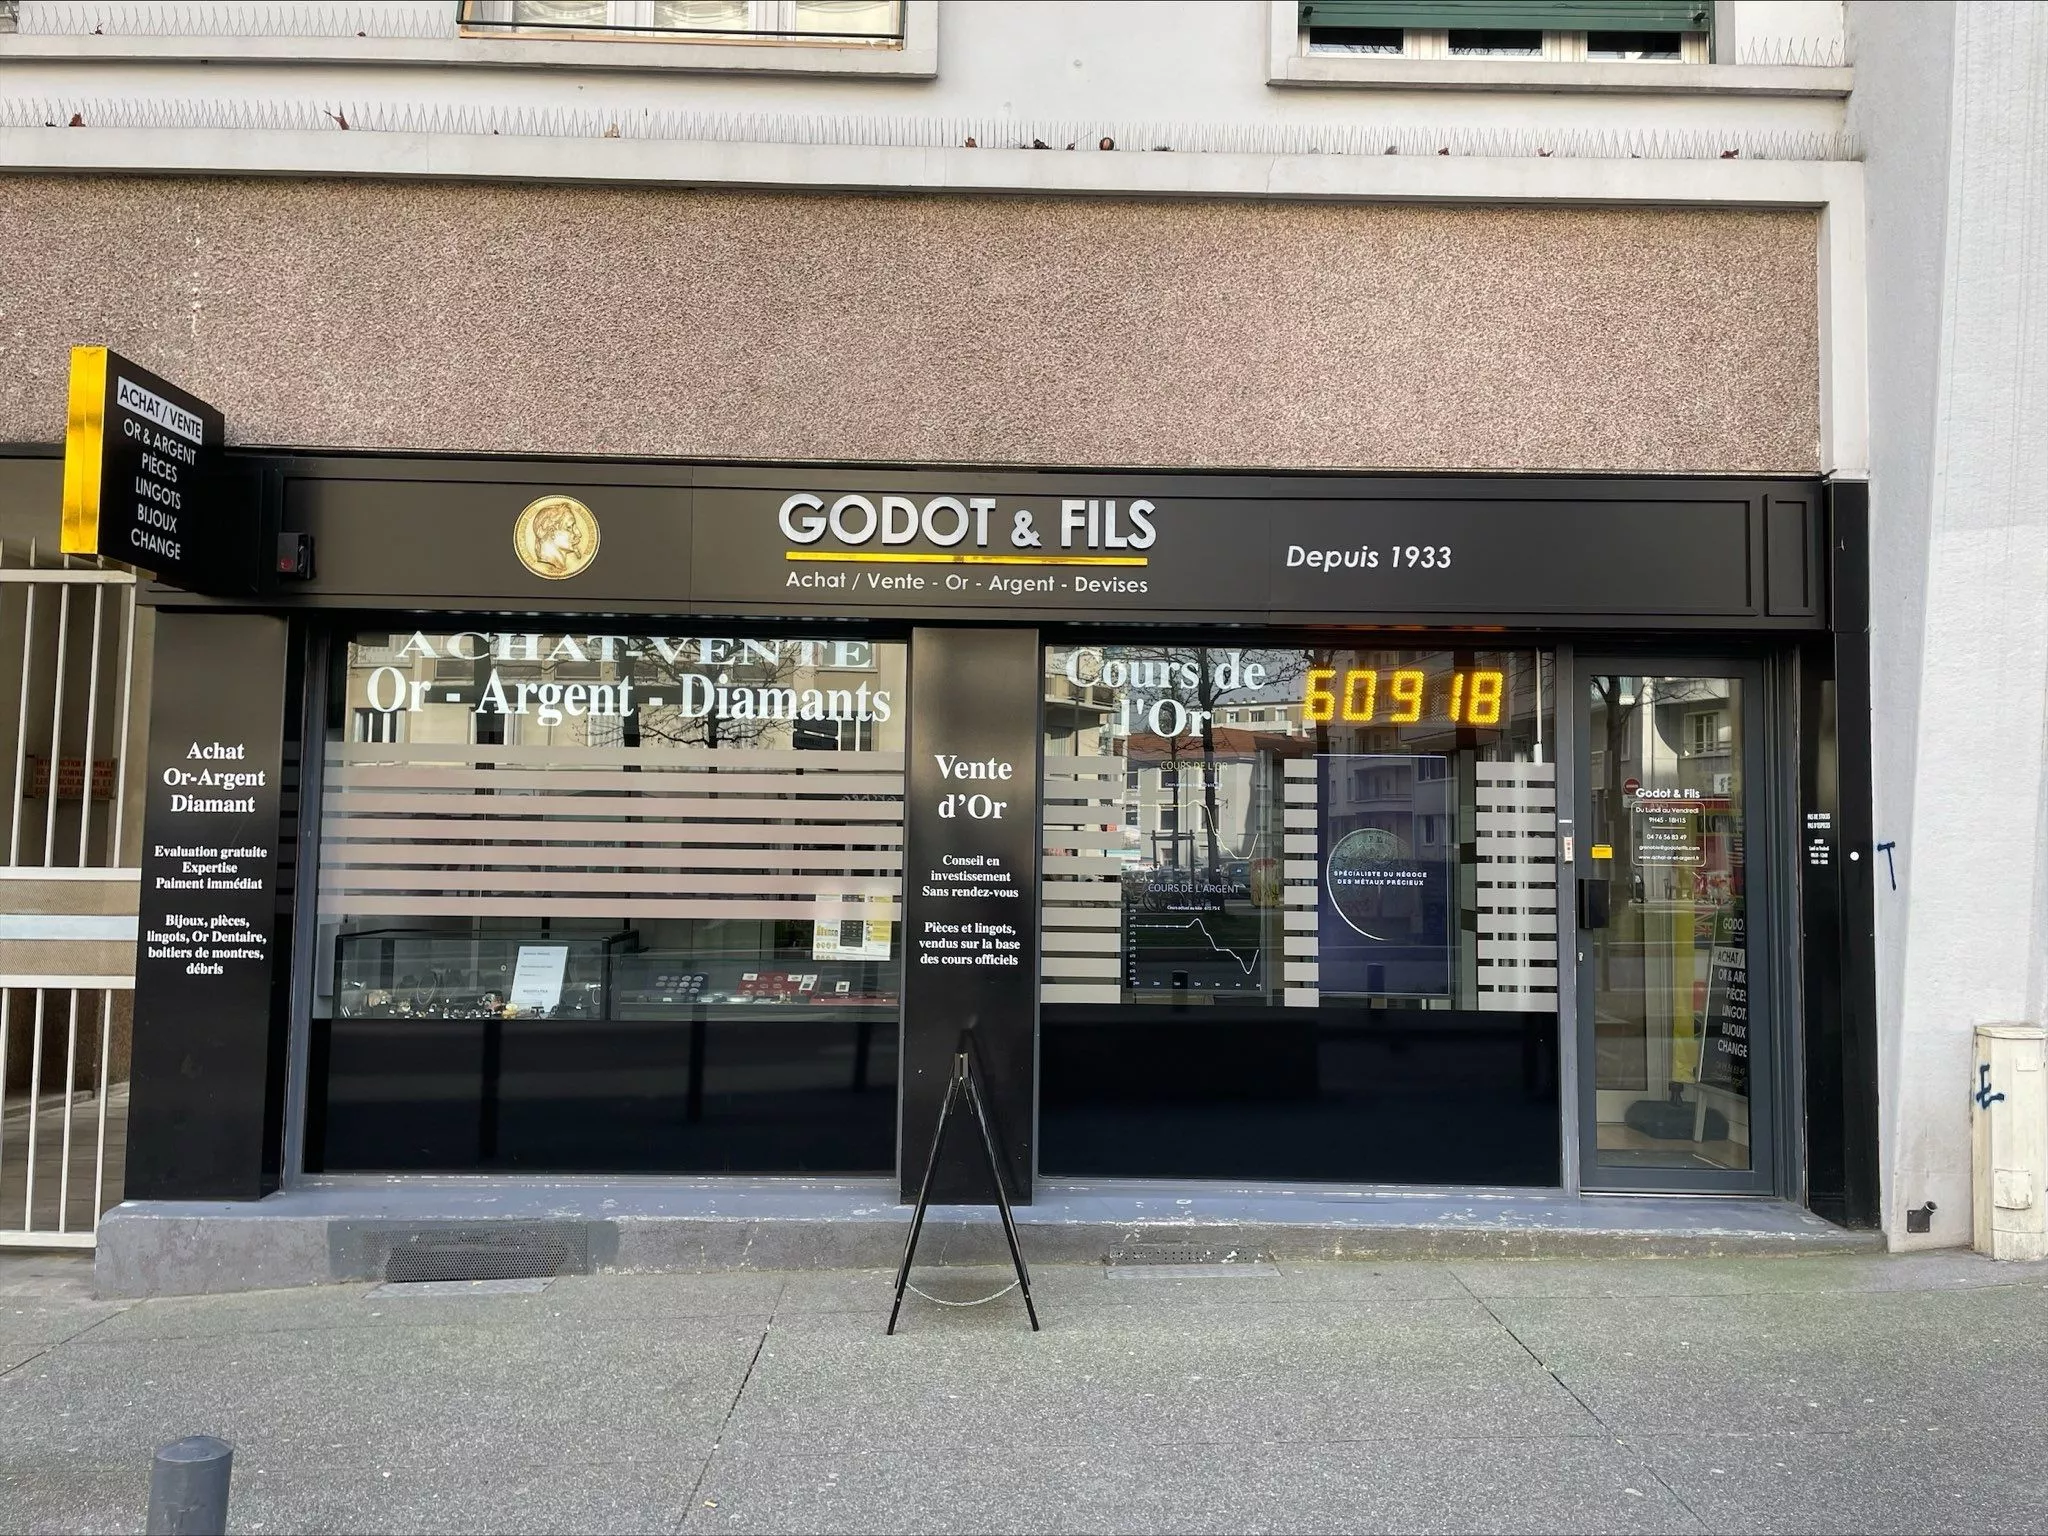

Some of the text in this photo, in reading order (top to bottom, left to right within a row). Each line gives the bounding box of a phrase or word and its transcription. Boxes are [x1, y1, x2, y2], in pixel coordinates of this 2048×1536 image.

[120, 384, 201, 439] ACHAT / VENTE
[123, 418, 196, 466] OR & ARGENT
[142, 452, 178, 483] PIÈCES
[135, 476, 181, 510] LINGOTS
[138, 503, 177, 533] BIJOUX
[778, 493, 1157, 550] GODOT & FILS
[131, 528, 181, 560] CHANGE
[1286, 545, 1452, 572] Depuis 1933
[786, 571, 846, 589] Achat
[852, 572, 861, 591] /
[867, 572, 925, 590] Vente
[945, 574, 969, 591] Or
[988, 575, 1055, 595] Argent
[1075, 576, 1148, 594] Devises
[396, 630, 872, 668] ACHAT-VENTE
[1066, 649, 1266, 690] Cours de
[367, 666, 891, 727] Or - Argent - Diamants
[1304, 669, 1503, 724] 60918
[1119, 698, 1211, 738] l'Or
[186, 741, 245, 760] Achat
[934, 754, 1013, 780] Vente
[1161, 761, 1228, 770] COURS DE L'OR
[163, 768, 266, 790] Or-Argent
[1636, 788, 1700, 798] Godot & Fils
[170, 794, 255, 813] Diamant
[938, 794, 1008, 819] d’Or
[154, 845, 268, 860] Evaluation gratuite
[942, 854, 1000, 866] Conseil en
[182, 861, 238, 875] Expertise
[930, 870, 1011, 882] investissement
[1396, 870, 1427, 878] NÉGOCE
[156, 877, 263, 890] Paiment immédiat
[1148, 884, 1240, 893] COURS DE L'ARGENT
[1387, 878, 1424, 886] PRÉCIEUX
[922, 886, 1019, 898] Sans rendez-vous
[165, 914, 250, 929] Bijoux, pièces,
[924, 921, 1016, 936] Pièces et lingots,
[1723, 917, 1745, 931] GODO
[147, 930, 267, 945] lingots, Or Dentaire,
[919, 938, 1021, 950] vendus sur la base
[194, 946, 209, 958] de
[212, 947, 264, 960] montres,
[920, 953, 1018, 966] des cours officiels
[1718, 950, 1739, 963] ACHAT
[186, 962, 224, 975] débris
[1722, 1004, 1747, 1020] LINGOT
[1722, 1022, 1746, 1038] BIJOUX
[1718, 1039, 1747, 1058] CHANGE
